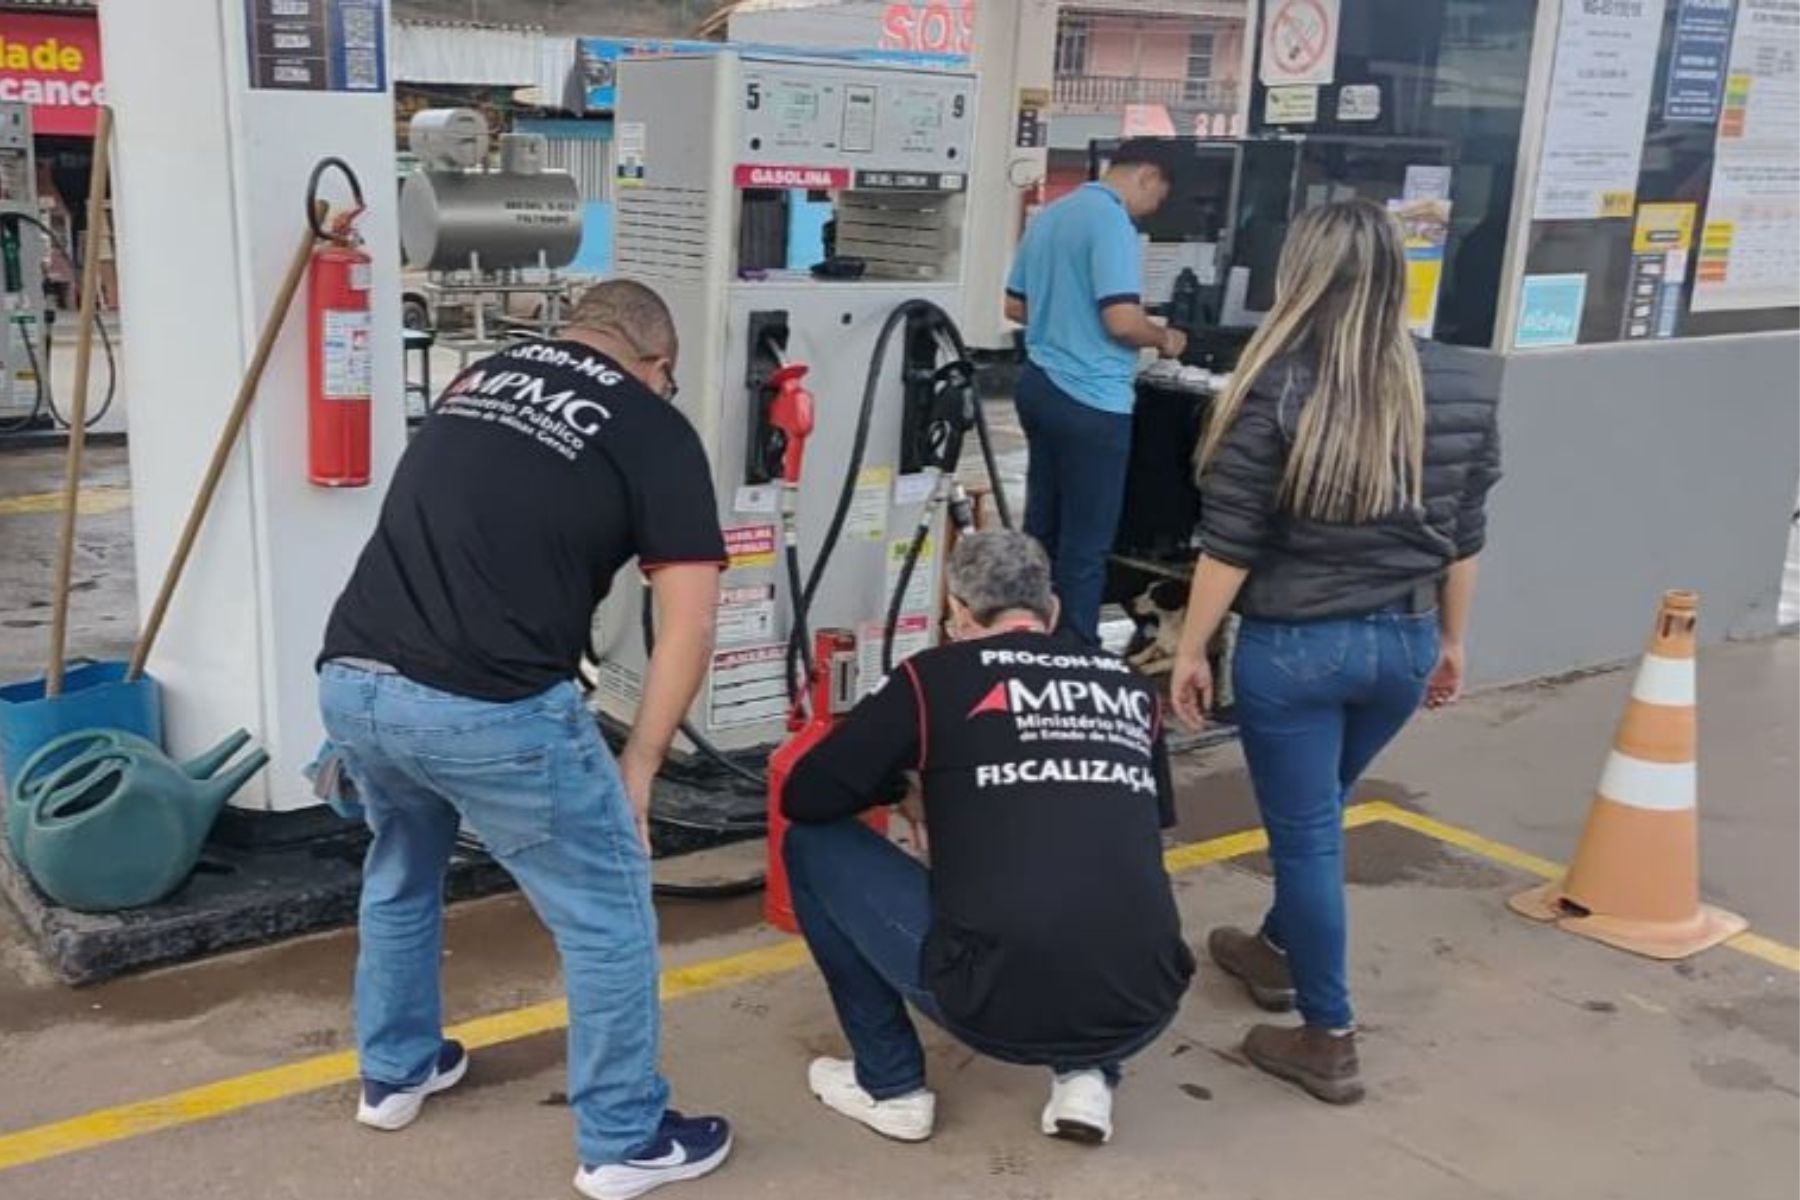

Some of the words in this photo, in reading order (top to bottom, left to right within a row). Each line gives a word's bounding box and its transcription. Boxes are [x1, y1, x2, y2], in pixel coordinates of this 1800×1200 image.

[746, 83, 760, 110] 5
[953, 94, 965, 118] 9
[751, 167, 832, 186] GASOLINA
[1015, 713, 1114, 732] Ministério
